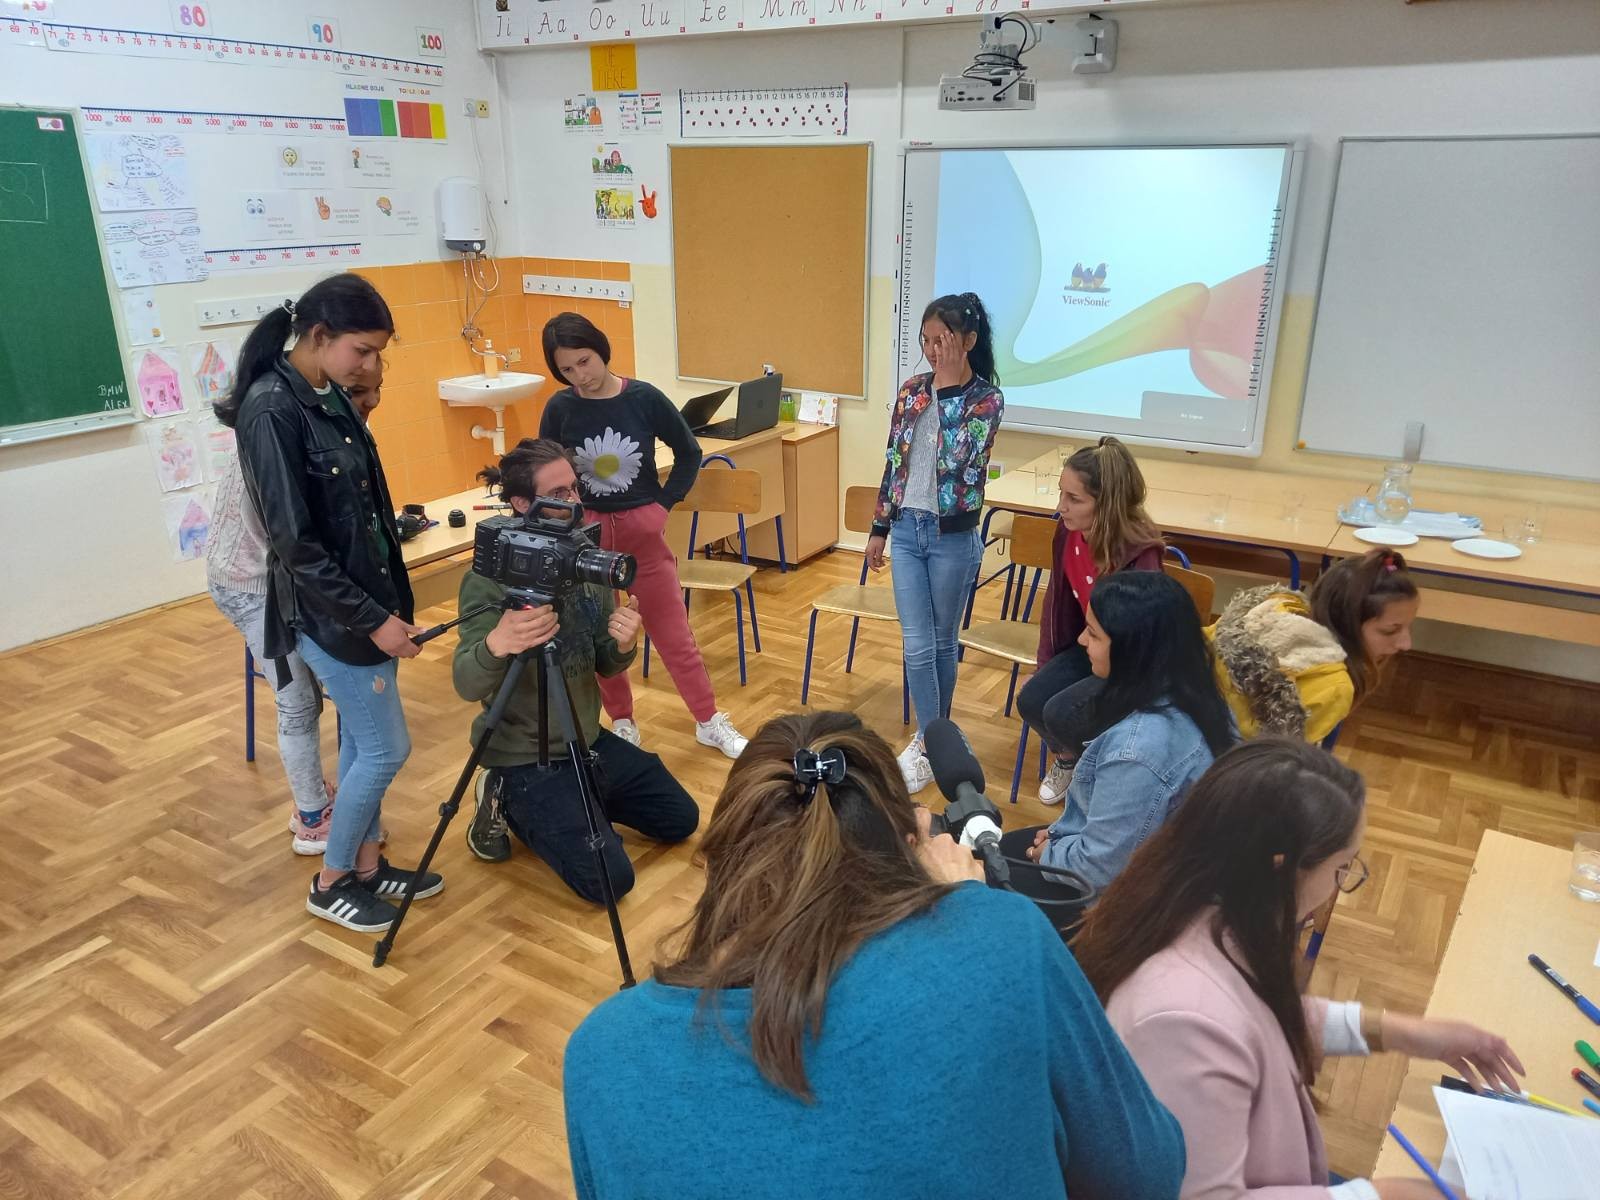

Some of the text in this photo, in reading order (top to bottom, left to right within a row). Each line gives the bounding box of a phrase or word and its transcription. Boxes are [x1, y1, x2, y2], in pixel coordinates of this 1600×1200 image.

[180, 5, 206, 27] 80
[10, 25, 20, 33] 69
[29, 27, 39, 35] 70
[48, 30, 58, 39] 71
[66, 32, 76, 40] 72
[83, 33, 92, 41] 73
[116, 36, 126, 44] 75
[133, 37, 142, 46] 76
[148, 38, 157, 46] 77
[164, 40, 173, 48] 78
[179, 41, 188, 49] 79
[193, 42, 202, 50] 80
[312, 23, 334, 44] 90
[420, 34, 442, 50] 100
[1062, 295, 1110, 307] ViewSonic
